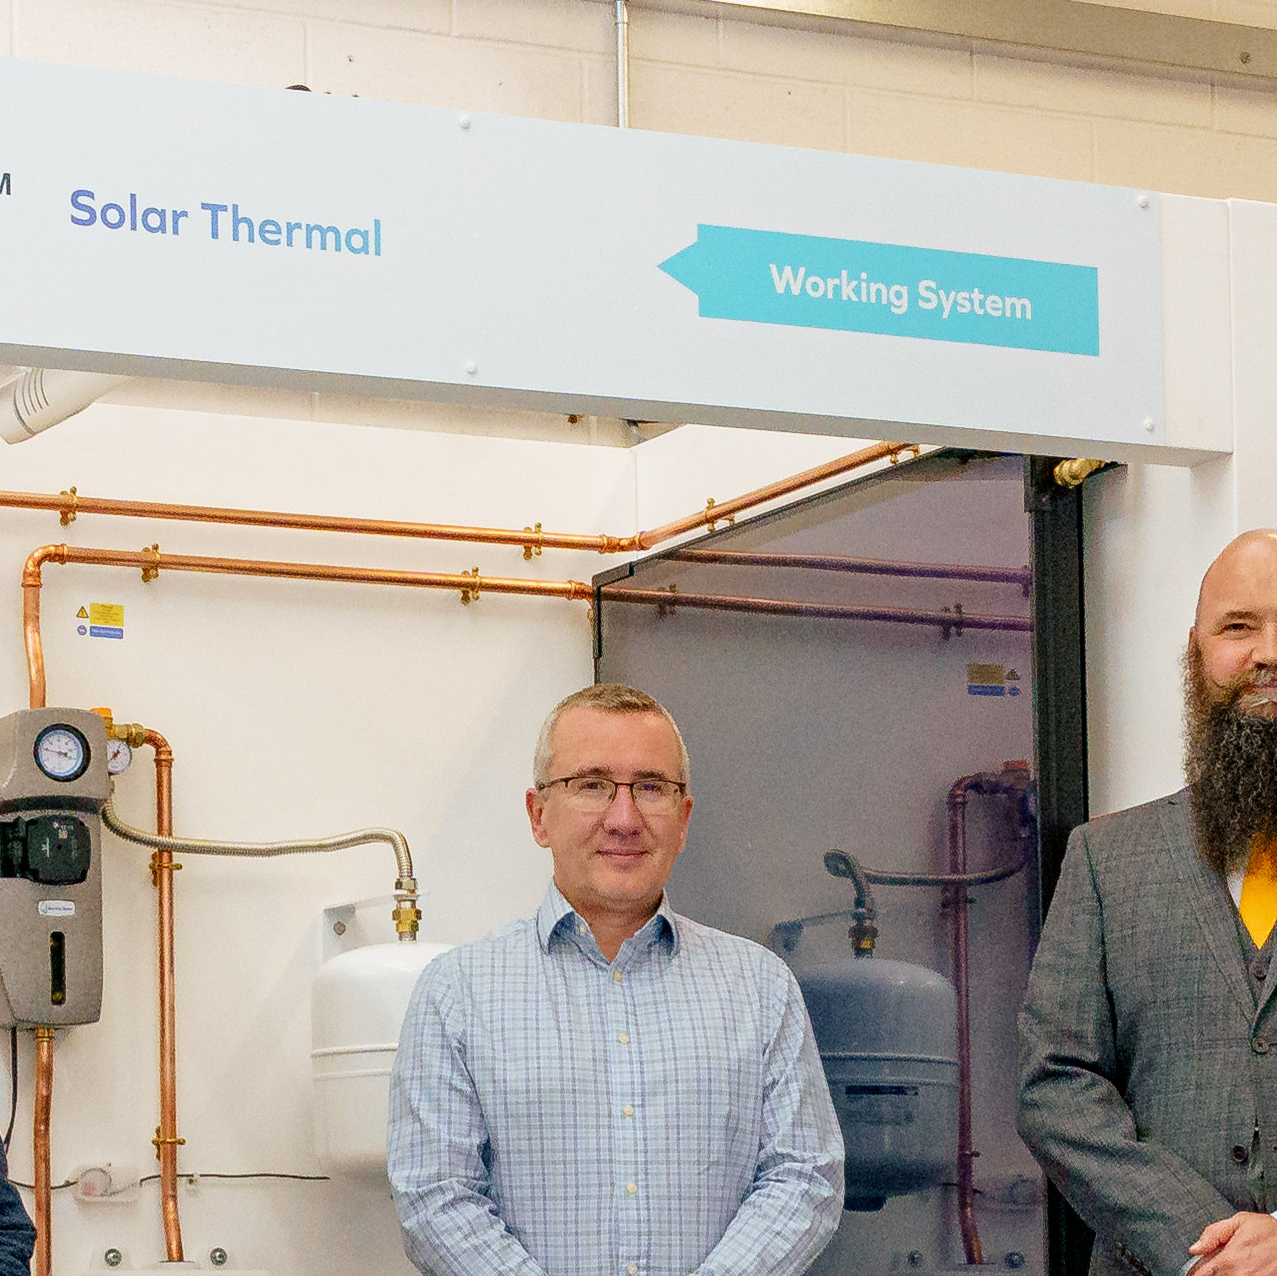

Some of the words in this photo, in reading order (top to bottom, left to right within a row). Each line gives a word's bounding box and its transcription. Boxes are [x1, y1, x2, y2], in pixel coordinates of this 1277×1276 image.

[70, 189, 189, 235] Solar
[201, 203, 382, 256] Thermal
[769, 263, 909, 315] Working
[917, 280, 1033, 320] System
